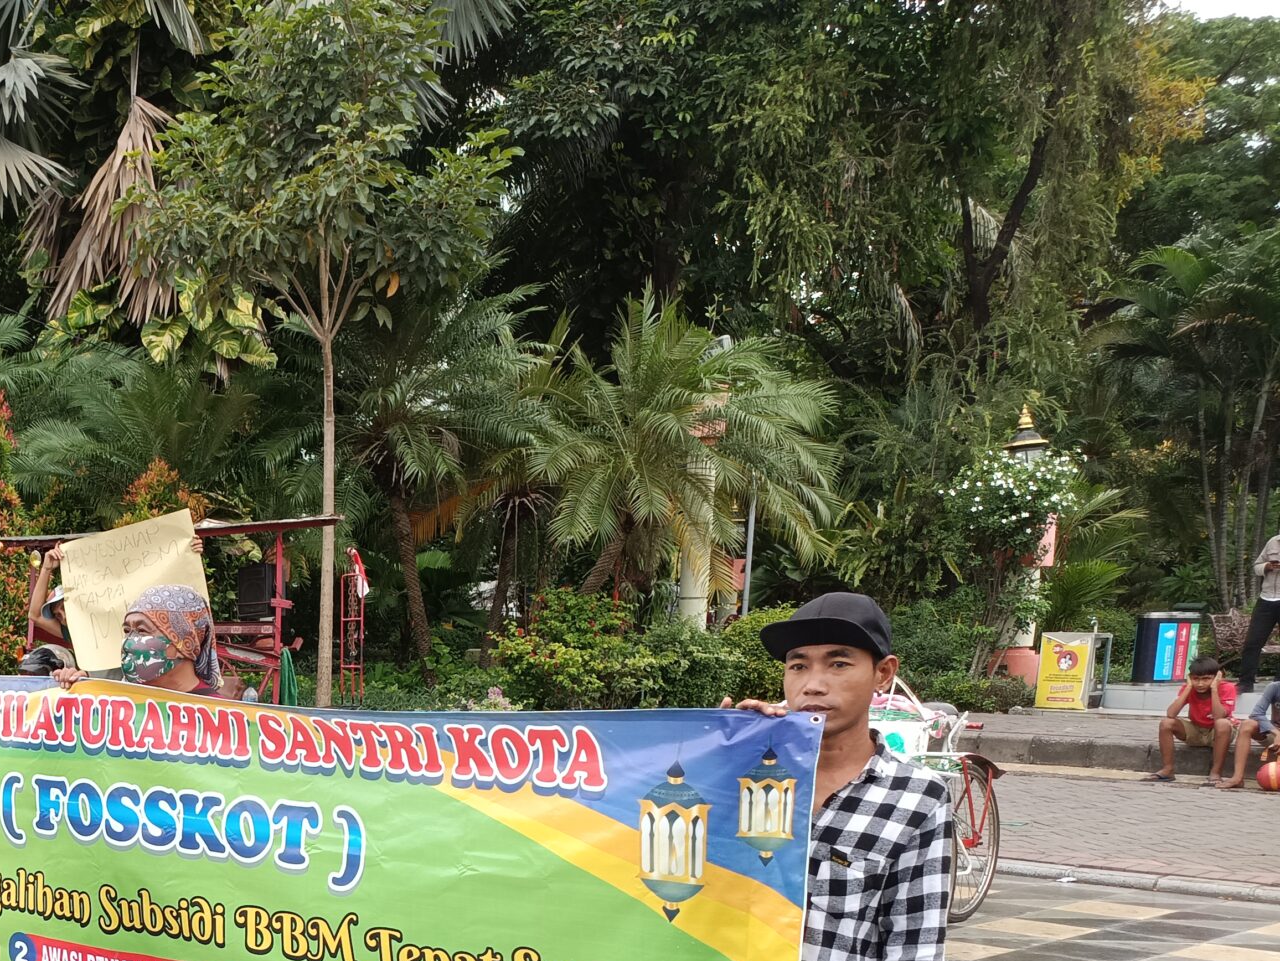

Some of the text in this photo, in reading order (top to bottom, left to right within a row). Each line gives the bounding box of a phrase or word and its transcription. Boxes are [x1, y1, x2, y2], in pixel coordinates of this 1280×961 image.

[123, 539, 182, 576] BBM
[256, 710, 444, 782] SANTRI
[445, 724, 608, 796] KOTA
[32, 773, 323, 871] FOSSKOT
[98, 883, 226, 949] Subsidi
